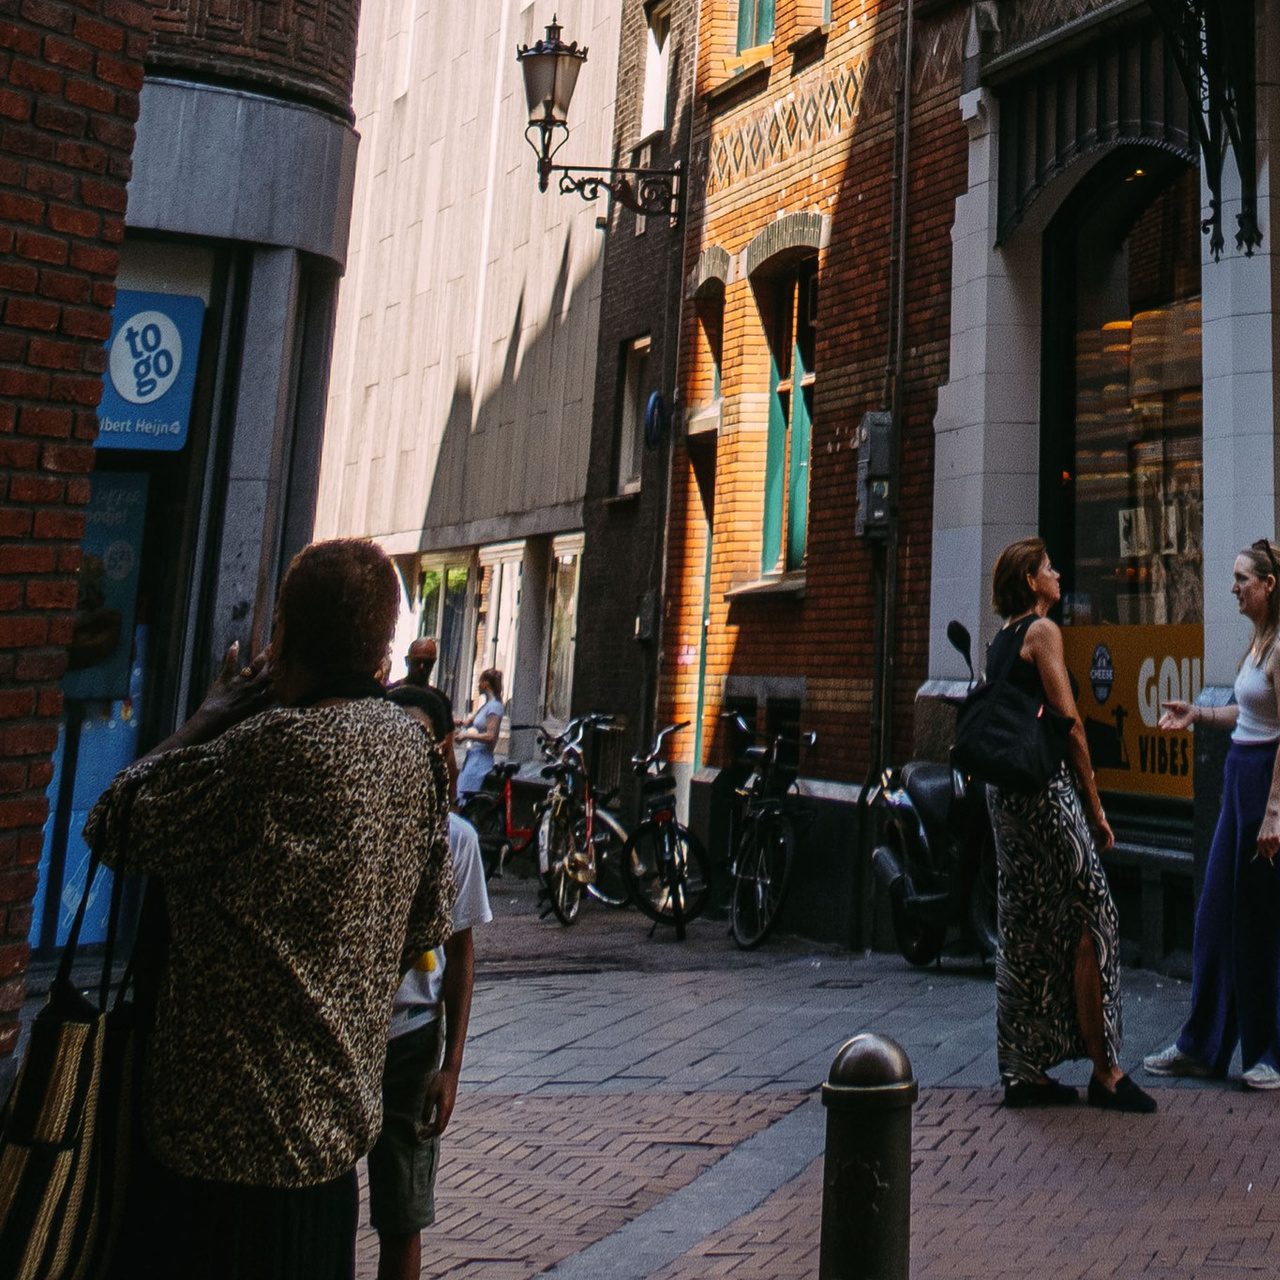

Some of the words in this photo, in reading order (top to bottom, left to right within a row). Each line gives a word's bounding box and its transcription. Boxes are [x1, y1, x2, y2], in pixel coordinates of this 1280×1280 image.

[125, 323, 161, 359] to
[134, 349, 173, 397] go
[99, 417, 132, 433] lbert
[135, 417, 169, 436] Heijn
[1090, 669, 1114, 680] CHEESE
[1138, 656, 1201, 732] GOU
[1138, 735, 1189, 776] VIBES
